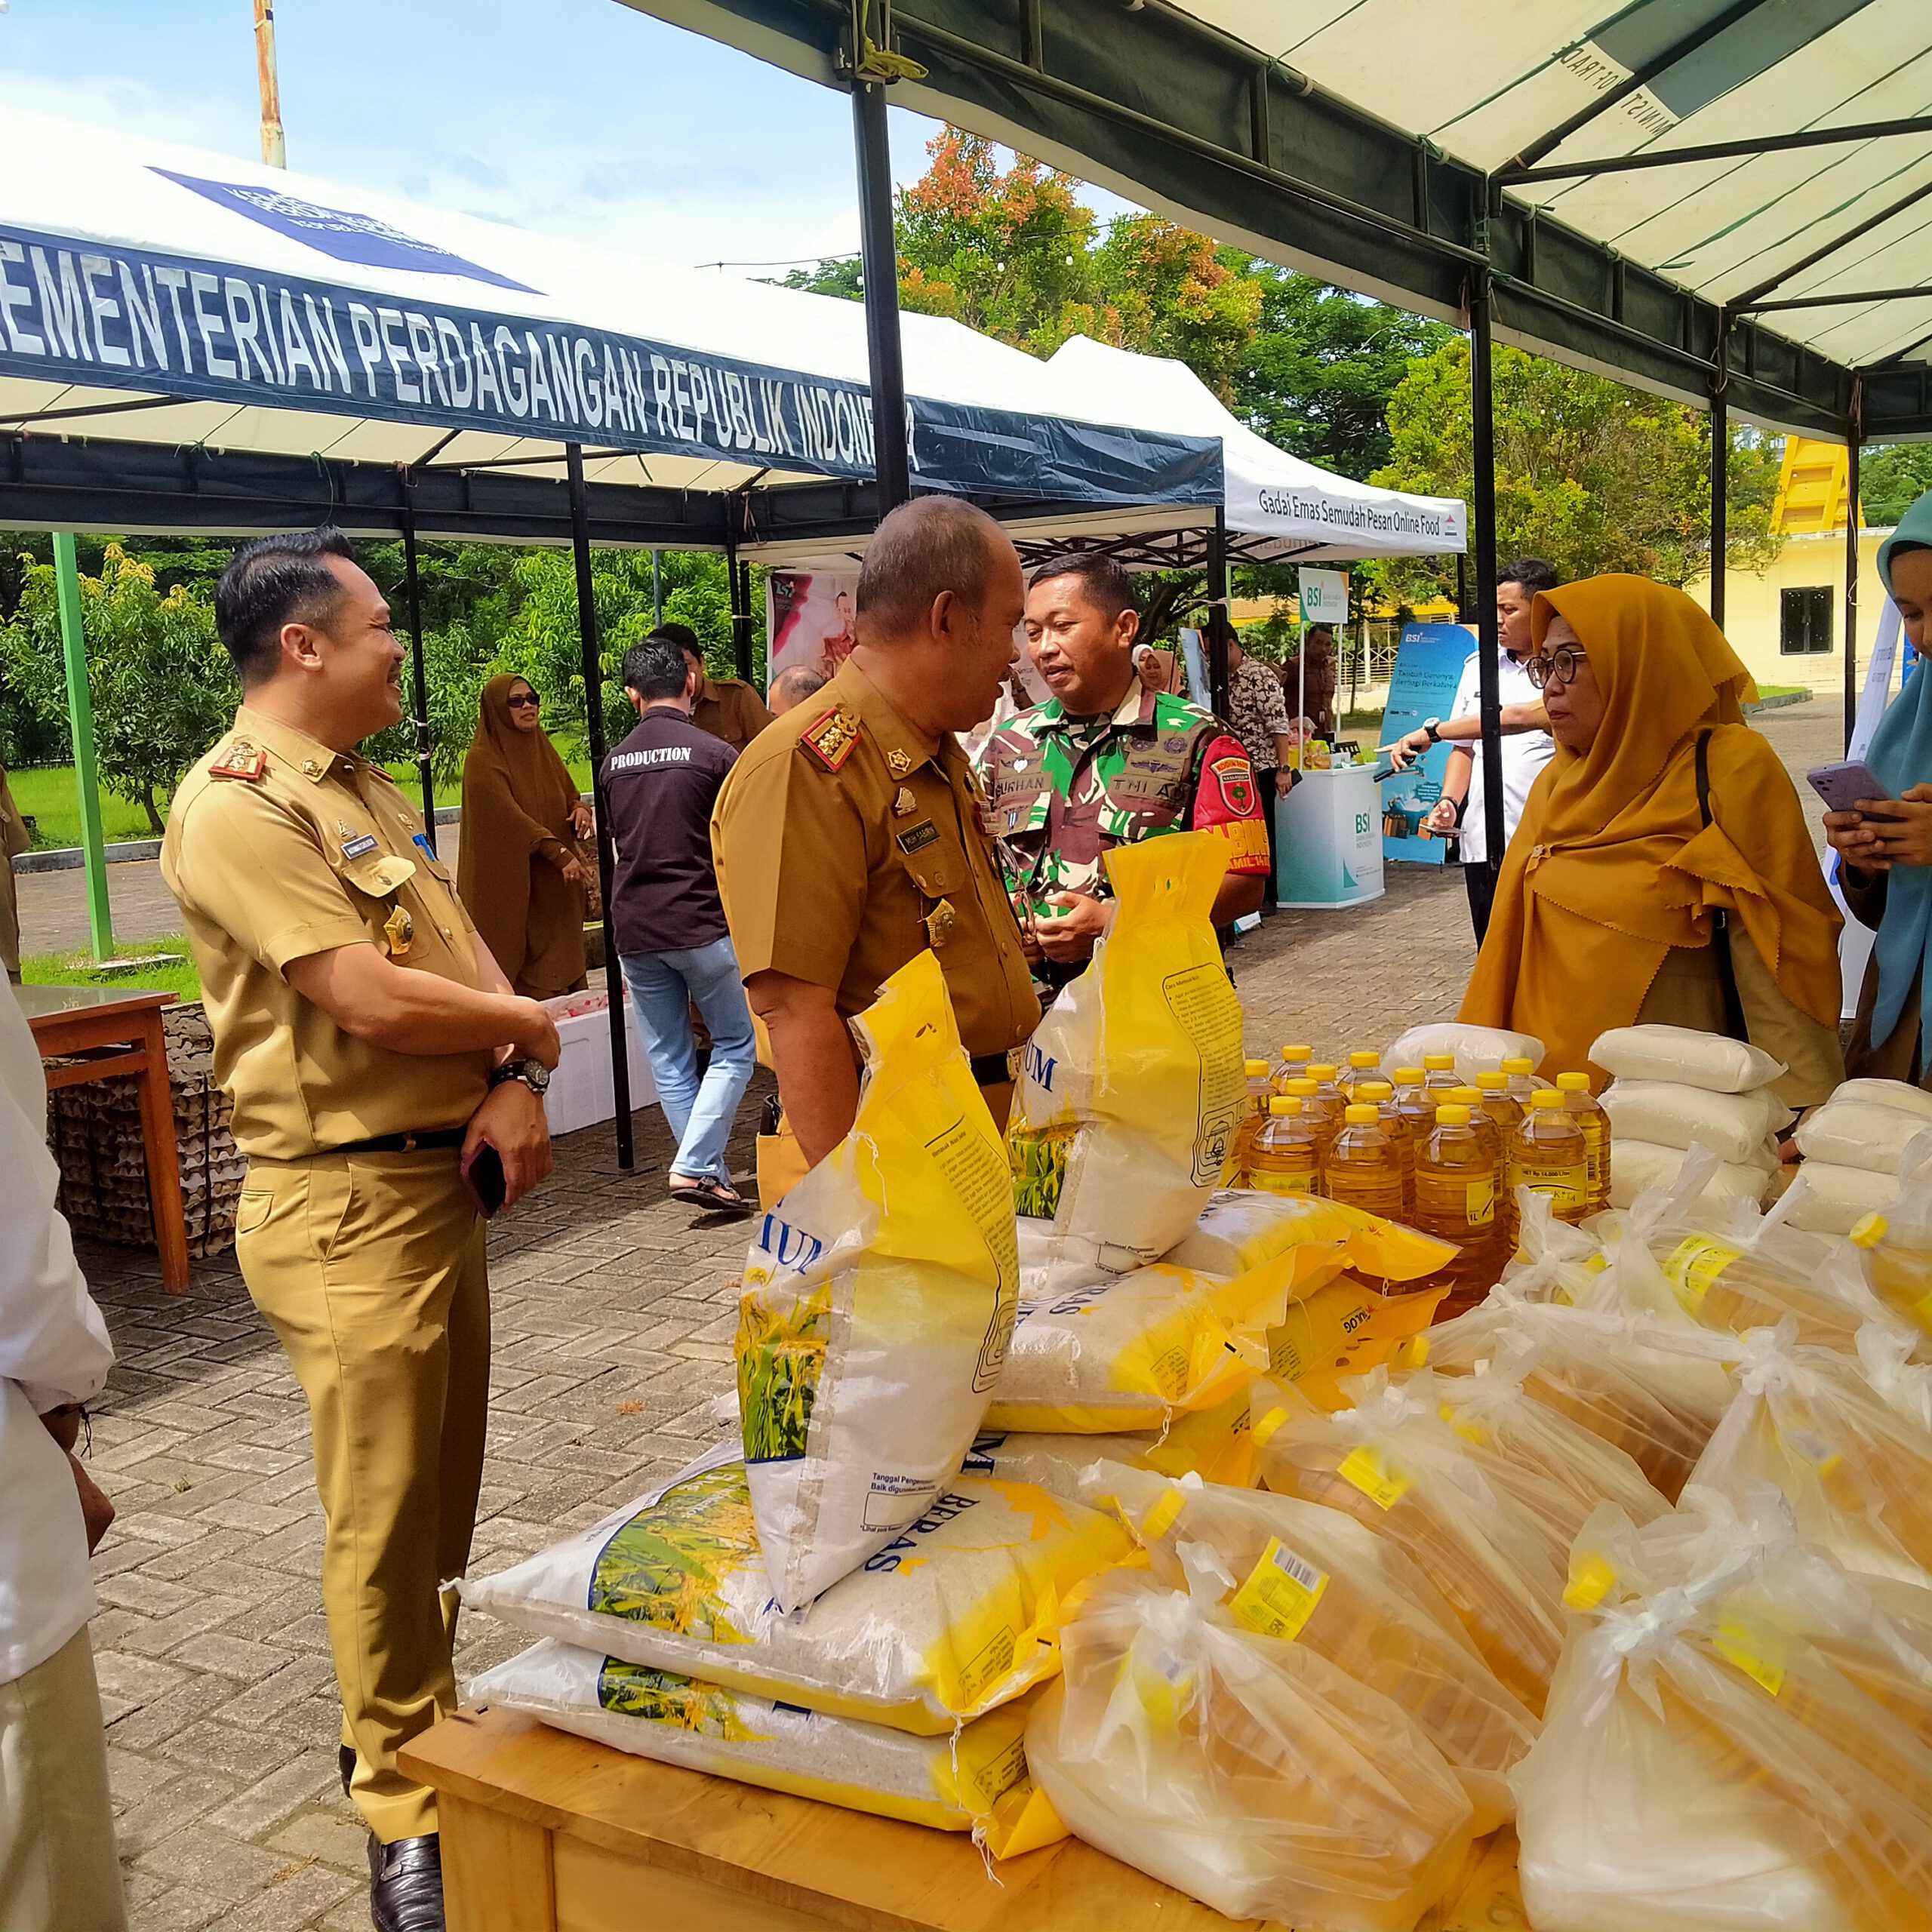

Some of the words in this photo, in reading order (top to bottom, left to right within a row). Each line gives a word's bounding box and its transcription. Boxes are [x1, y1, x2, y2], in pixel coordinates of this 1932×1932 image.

[0, 240, 352, 394] EMENTERIAN
[347, 302, 649, 433] PERDAGANGAN
[650, 353, 795, 457] REPUBLIK
[793, 383, 921, 472] INDONEA
[1259, 489, 1291, 516] Gadai
[1293, 495, 1320, 521] Emas
[1321, 500, 1366, 528] Semudah
[1367, 508, 1392, 531] Pesan
[1394, 510, 1420, 534] Online
[1420, 515, 1440, 537] Food
[1307, 586, 1321, 607] BSI
[1405, 634, 1420, 642] BSI
[610, 746, 692, 771] PRODUCTION
[1355, 813, 1370, 834] BSI
[870, 1482, 887, 1492] Baik
[872, 1472, 900, 1484] Tanggal
[863, 1492, 981, 1574] BERAS
